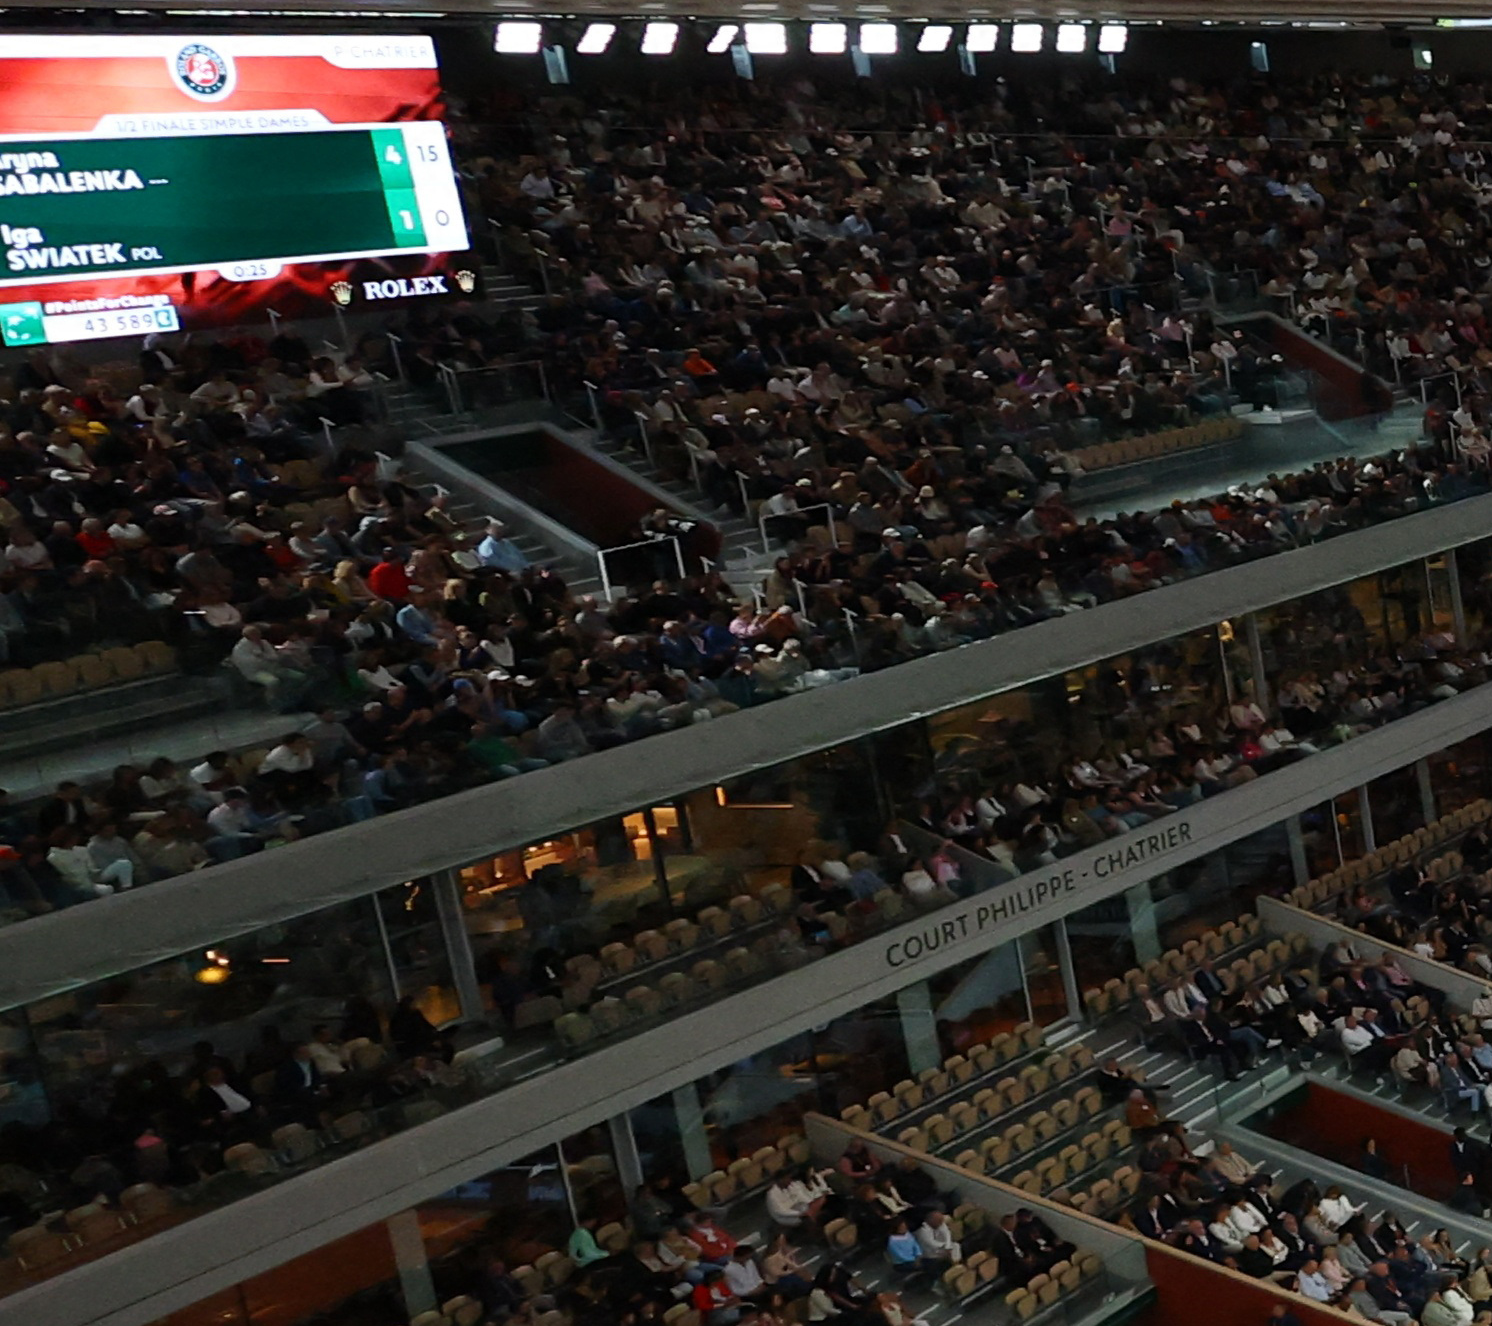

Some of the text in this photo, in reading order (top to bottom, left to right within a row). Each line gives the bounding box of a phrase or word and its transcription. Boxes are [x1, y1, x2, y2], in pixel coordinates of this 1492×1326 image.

[350, 45, 430, 59] CHATRIER
[142, 118, 196, 132] FINALE
[200, 116, 254, 131] SIMPLE
[258, 115, 309, 129] DAMES
[0, 151, 60, 175] ryna
[384, 144, 403, 165] 4
[417, 145, 439, 163] 15
[399, 210, 415, 230] 1
[1, 224, 44, 249] Iga
[7, 242, 163, 272] SWIATEK POL
[233, 264, 268, 278] 0:25
[363, 275, 449, 301] ROLEX
[84, 314, 153, 333] 43 589
[886, 914, 970, 967] COURT
[977, 871, 1075, 931] PHILIPPE
[1093, 822, 1193, 880] CHATRIER
